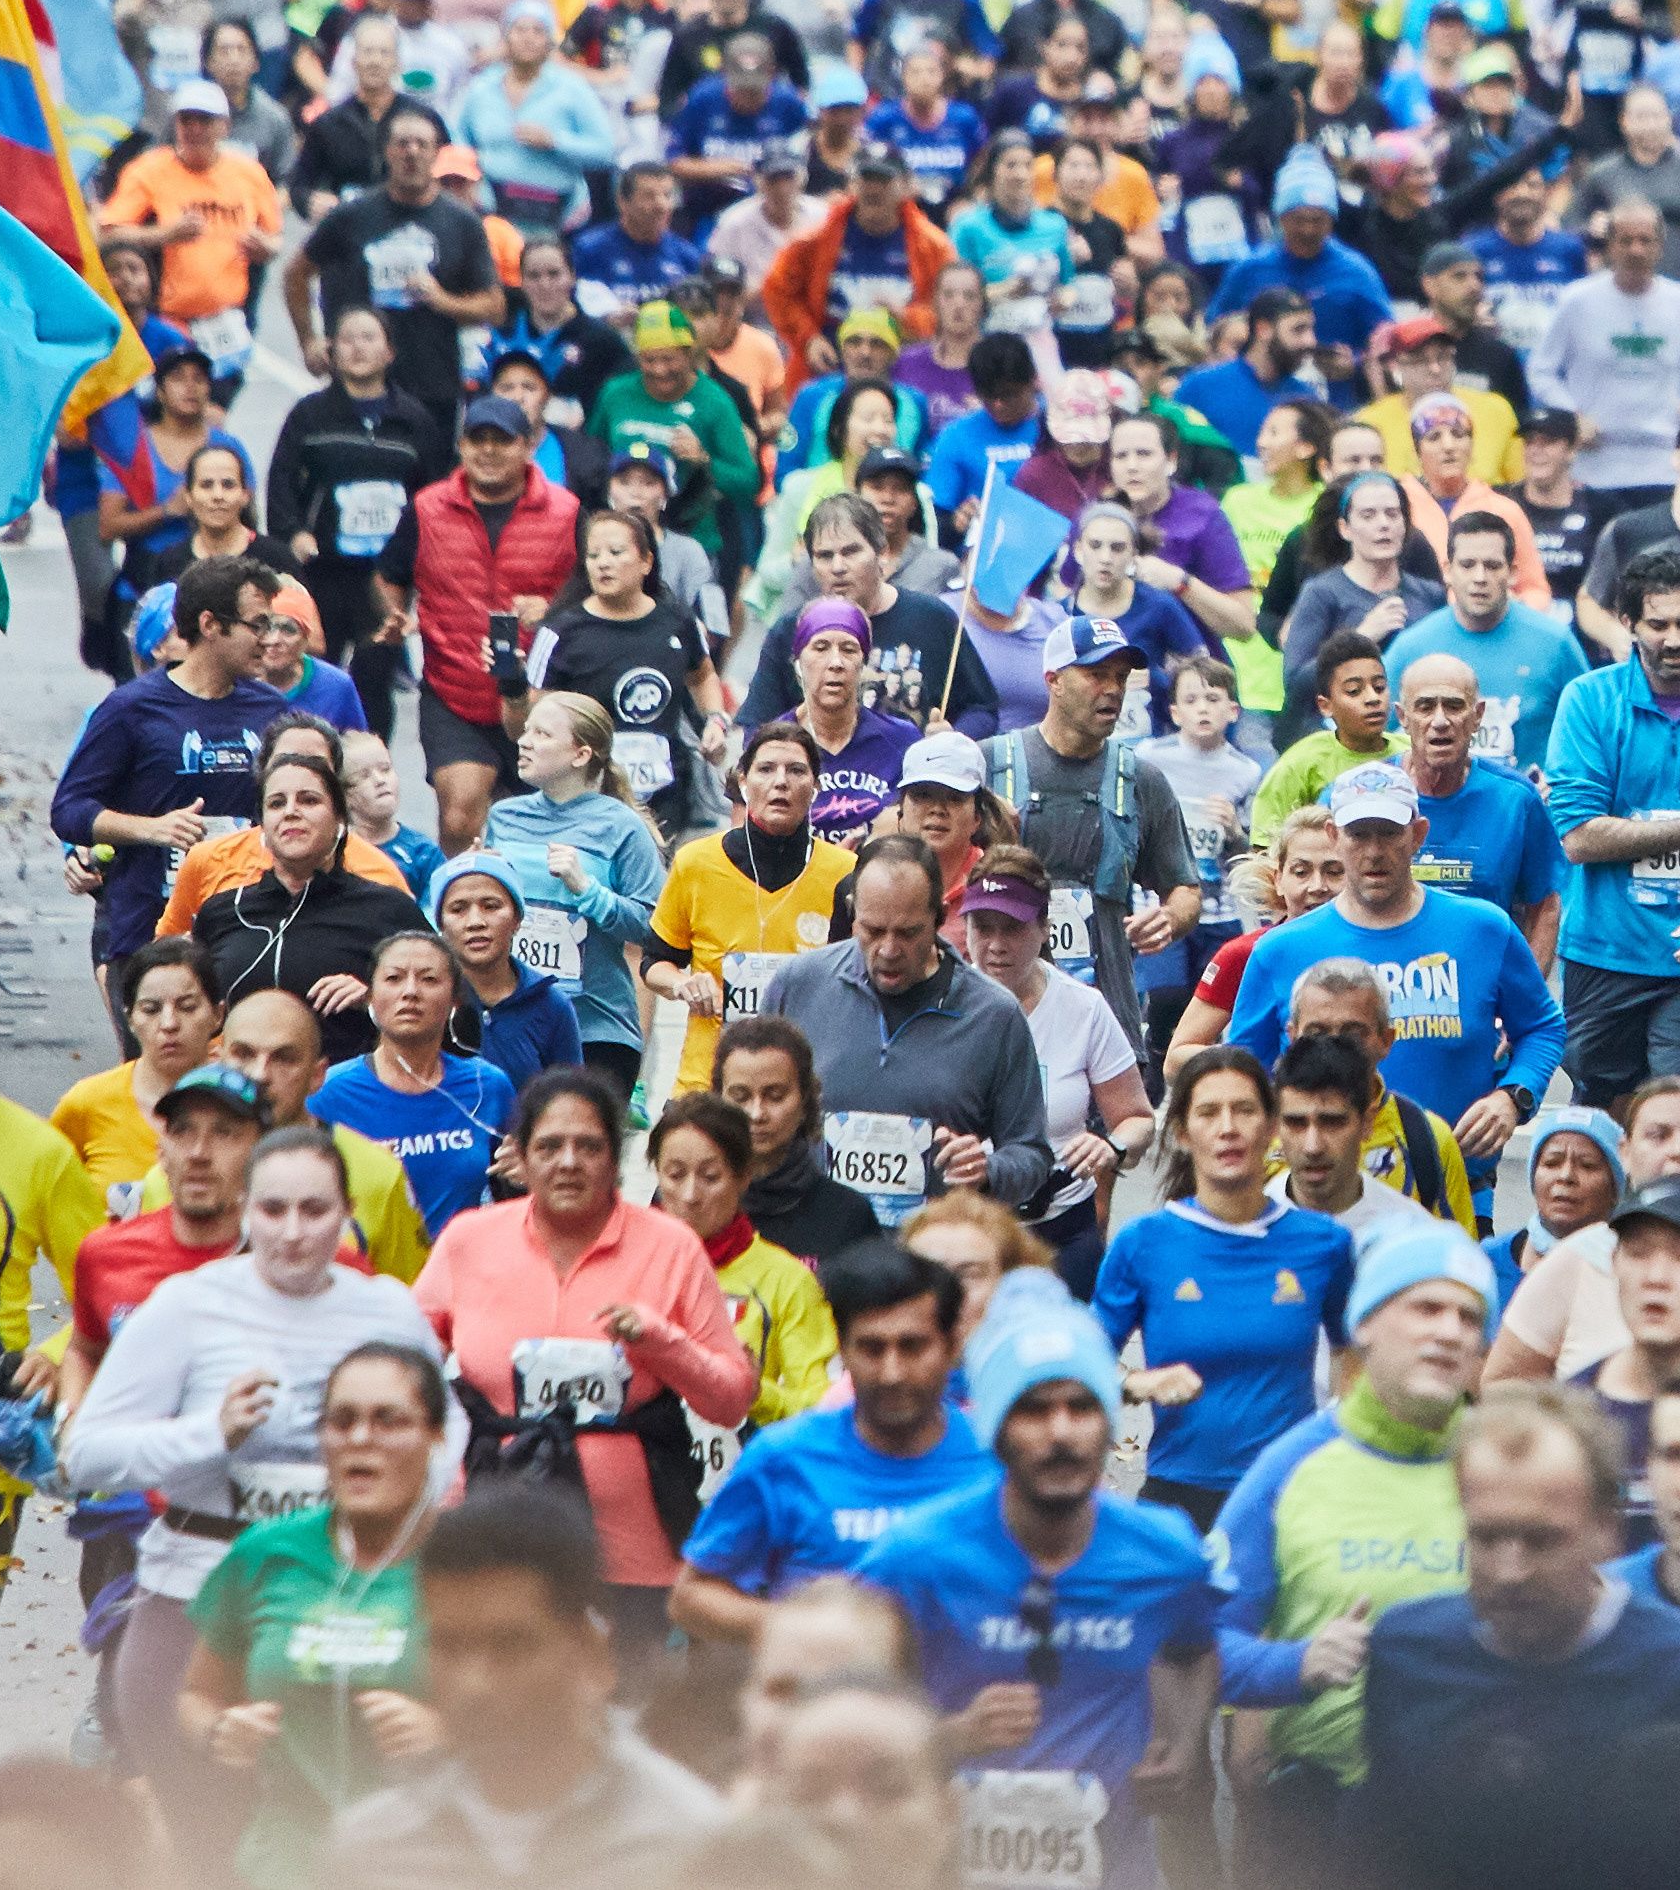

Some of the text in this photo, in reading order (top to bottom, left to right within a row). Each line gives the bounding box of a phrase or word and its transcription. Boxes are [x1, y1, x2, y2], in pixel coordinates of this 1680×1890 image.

[625, 762, 656, 786] 781
[817, 770, 890, 799] RCURY
[1441, 866, 1472, 879] MILE
[517, 938, 561, 969] 8811
[1373, 960, 1459, 1003] RON
[724, 986, 759, 1015] K11
[1393, 1015, 1462, 1041] RATHON
[436, 1128, 474, 1150] TCS
[828, 1151, 908, 1185] K6852
[832, 1508, 905, 1542] TEA
[1339, 1538, 1468, 1575] BRASI
